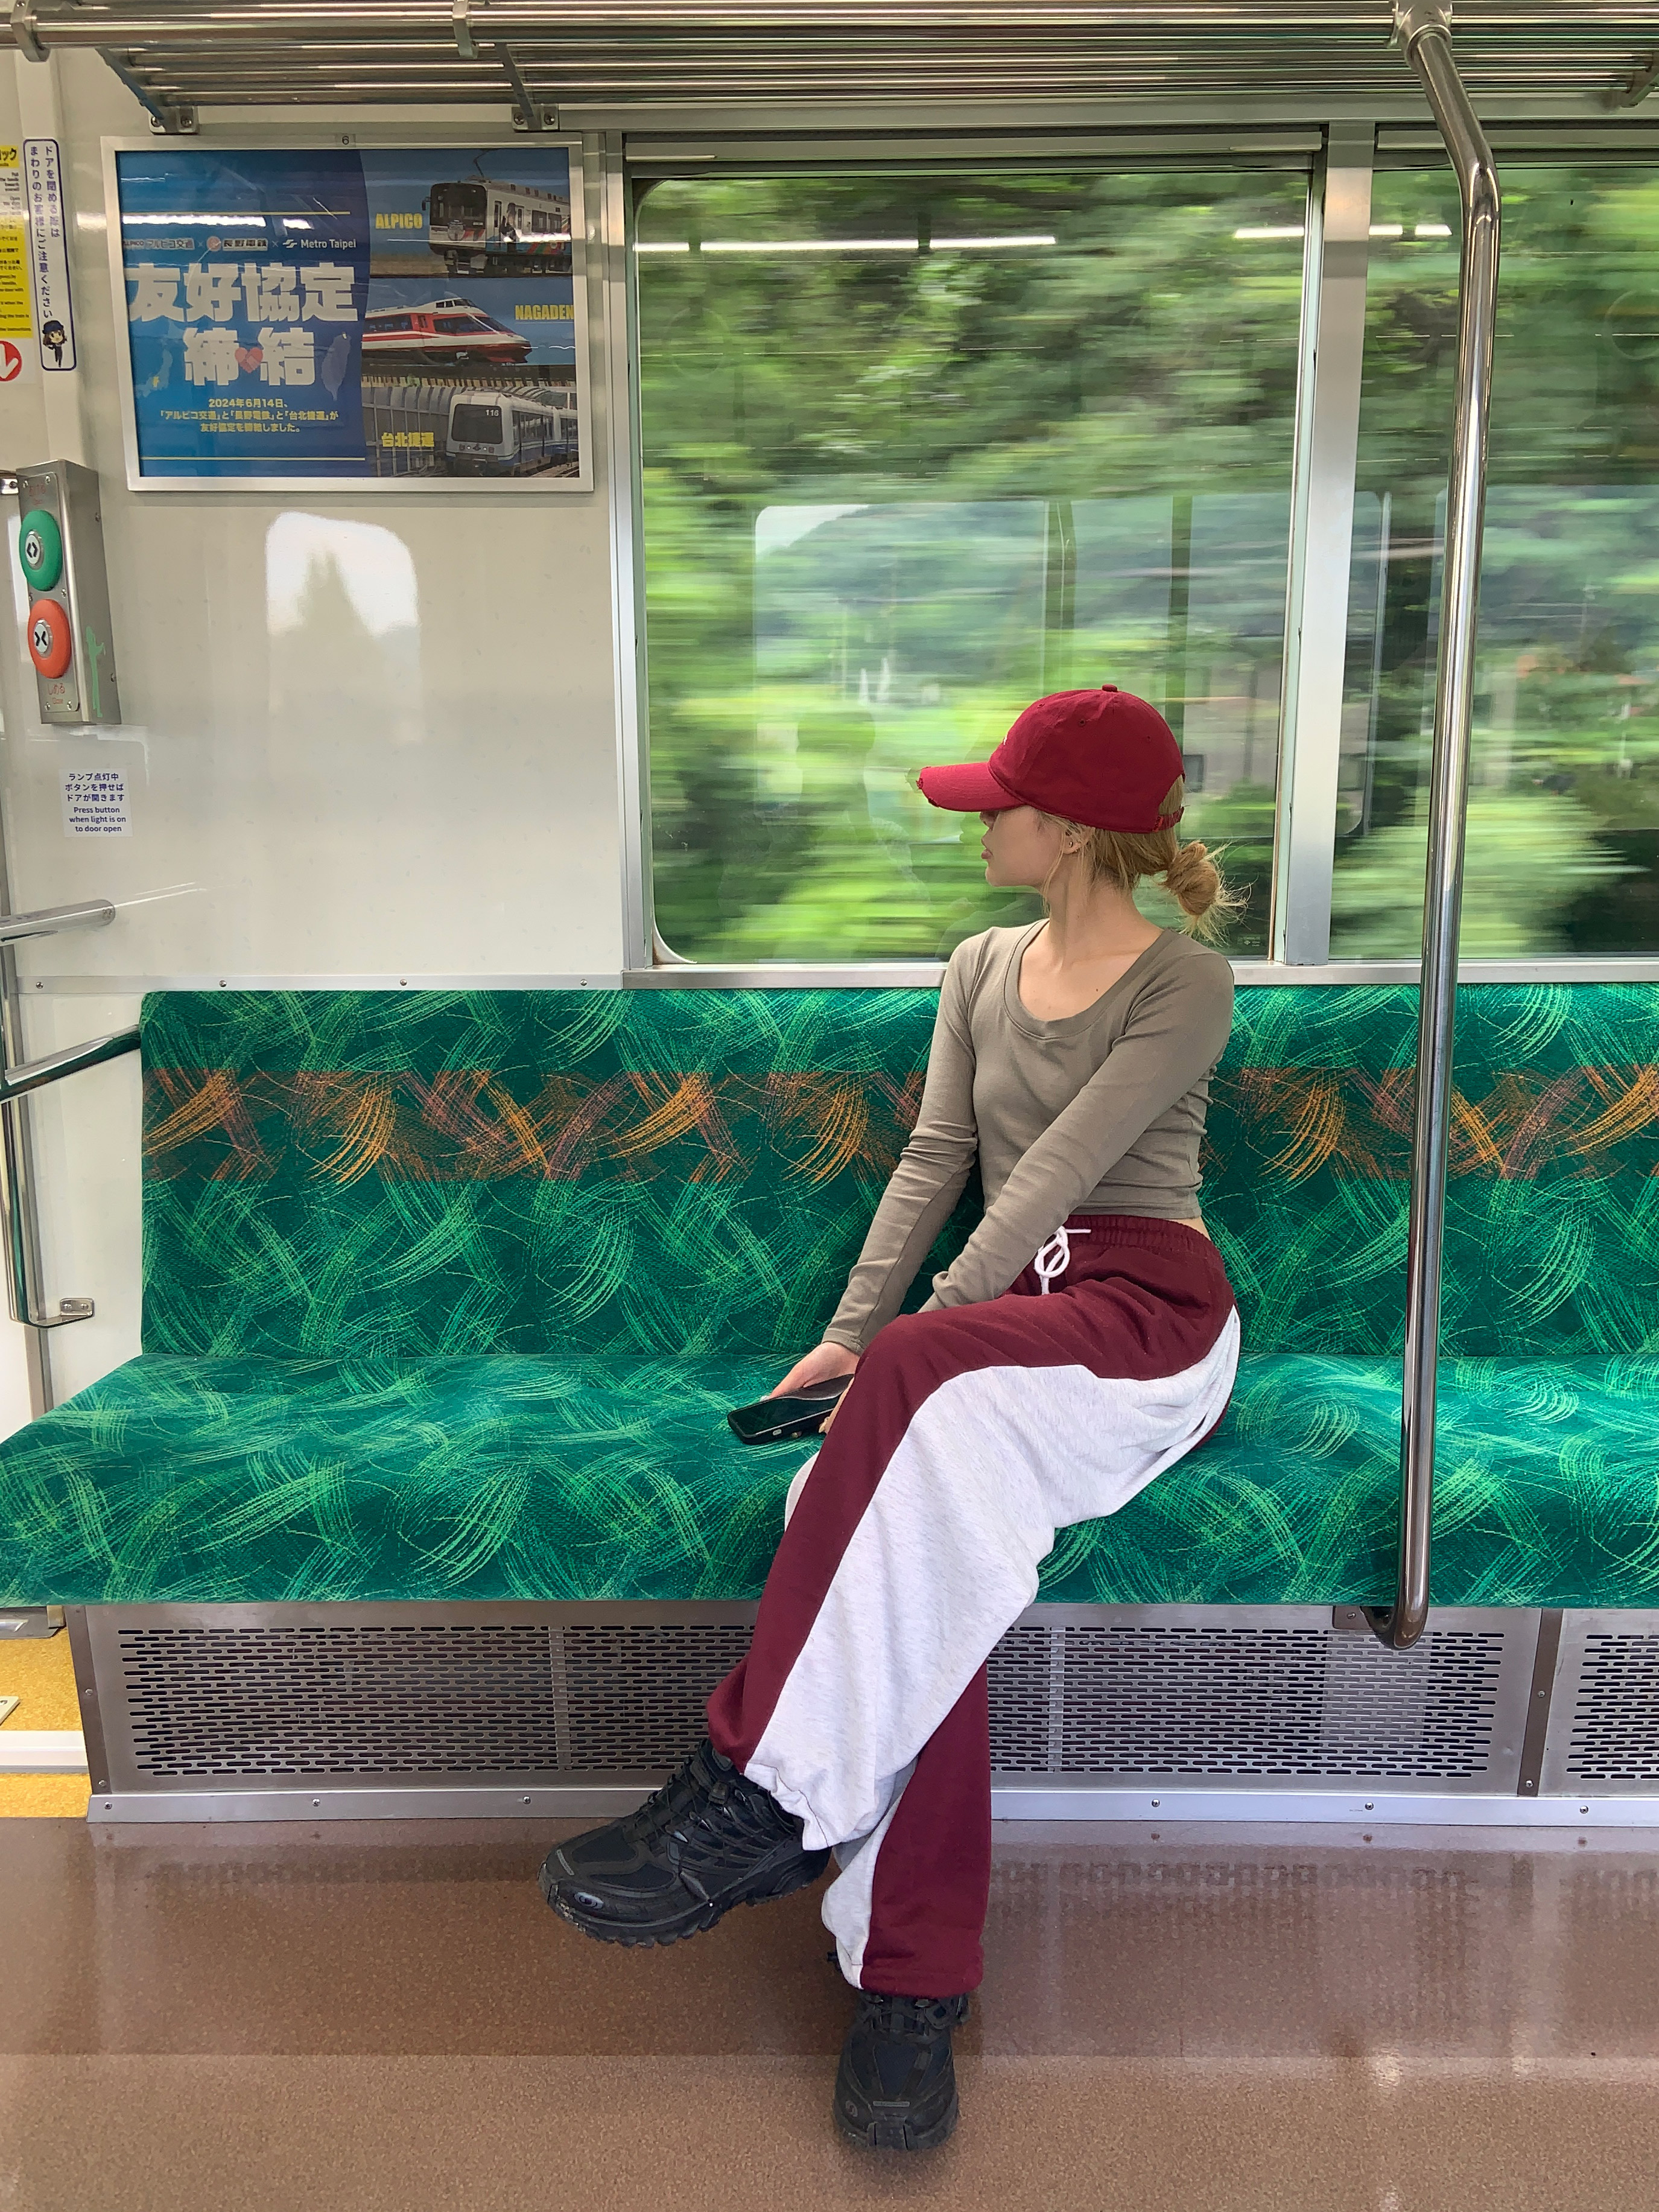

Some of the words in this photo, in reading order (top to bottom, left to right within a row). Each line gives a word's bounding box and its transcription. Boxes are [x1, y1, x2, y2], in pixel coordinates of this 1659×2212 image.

[341, 136, 349, 145] 6
[375, 213, 422, 229] ALPICO
[300, 239, 328, 249] Metro
[329, 239, 357, 250] Taipei
[124, 262, 358, 322] 友好協定
[515, 304, 574, 320] NAGADEN
[208, 398, 288, 408] 2024年6月14日、
[65, 783, 124, 792] ボタンを押せば
[90, 815, 108, 824] light
